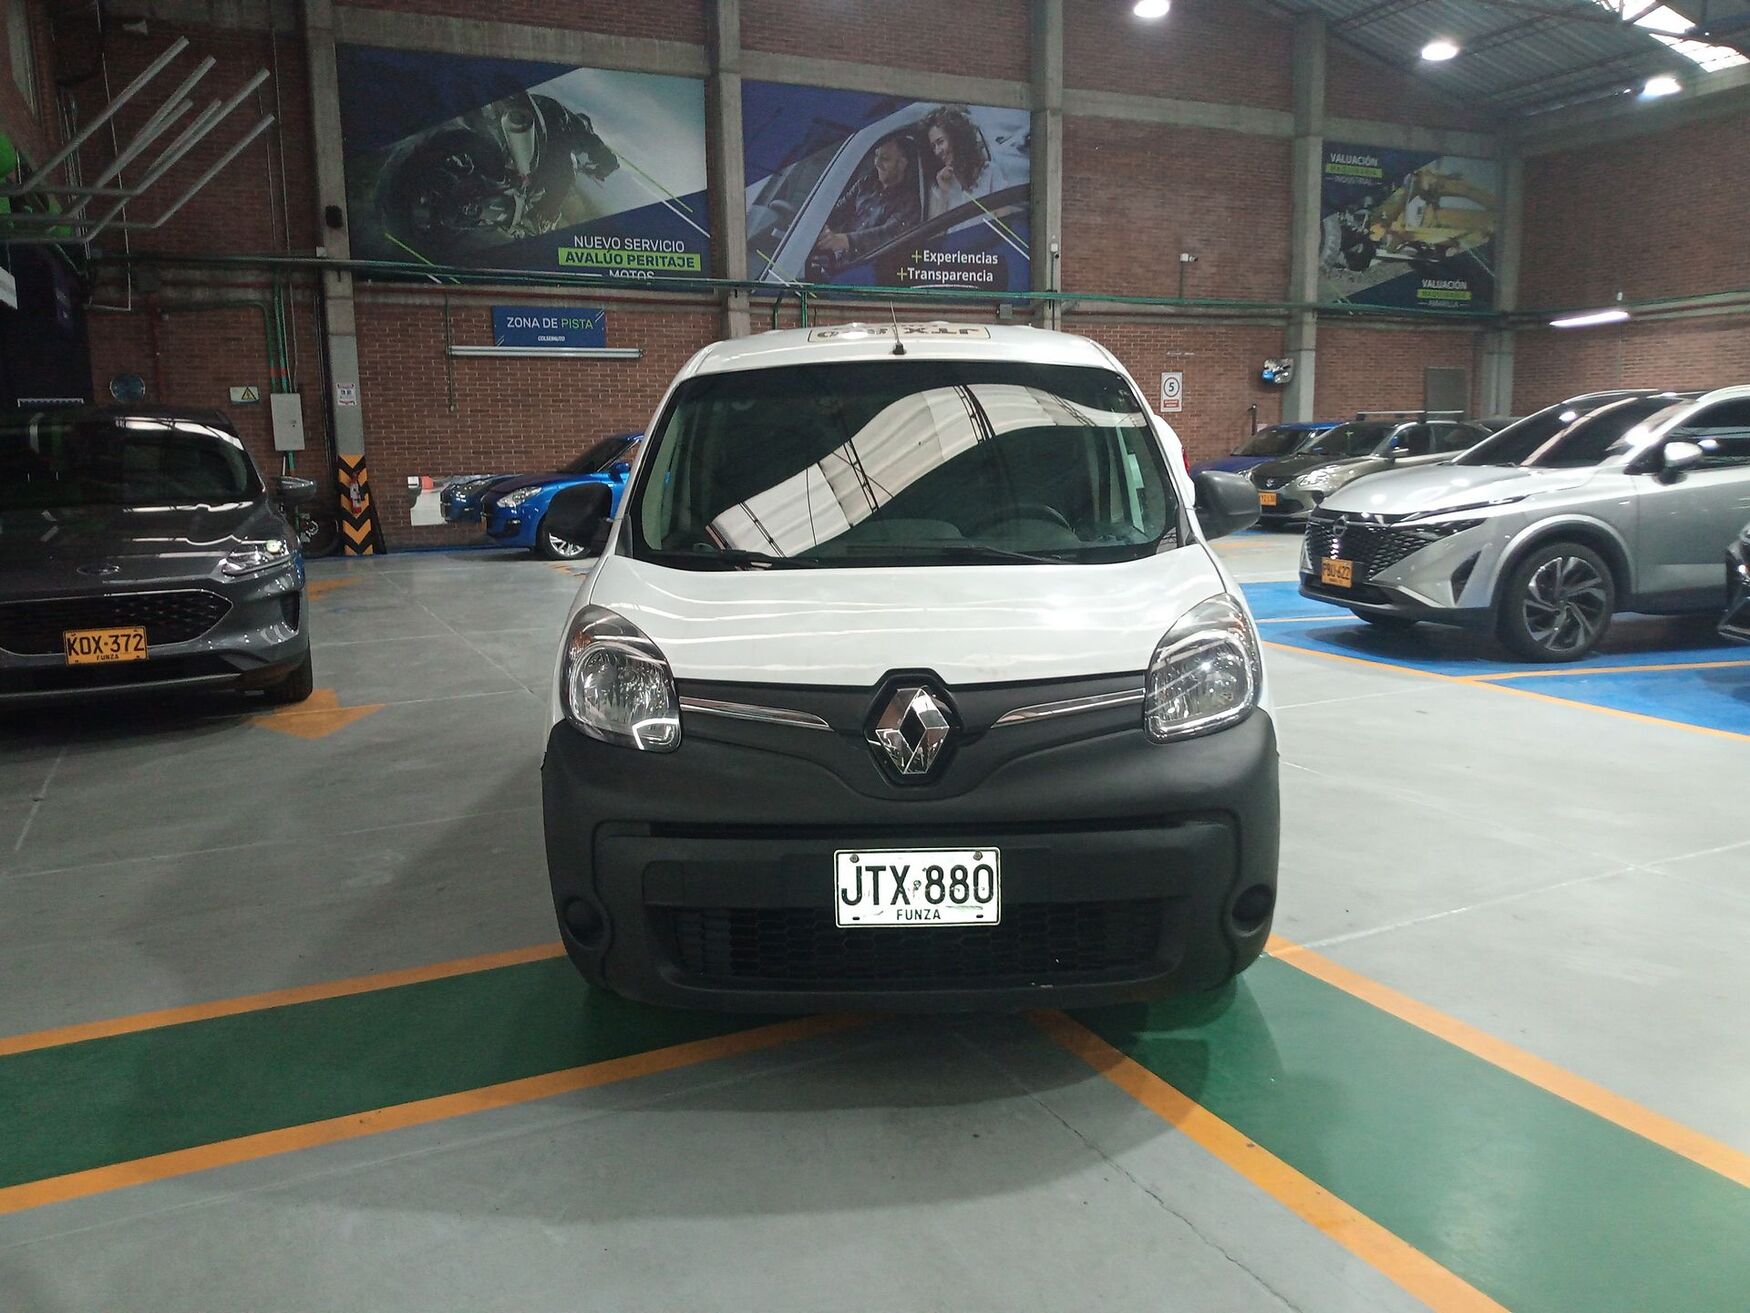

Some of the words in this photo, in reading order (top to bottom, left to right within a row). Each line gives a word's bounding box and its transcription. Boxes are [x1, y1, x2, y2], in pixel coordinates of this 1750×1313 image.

[574, 235, 621, 250] NUEVO
[624, 238, 685, 253] SERVICIO
[565, 250, 623, 266] AVALÚO
[627, 254, 695, 269] PERITAJE
[506, 317, 540, 329] ZONA
[543, 318, 558, 329] DE
[561, 319, 593, 330] PISTA
[1168, 382, 1175, 392] 5
[896, 908, 942, 921] FUNZA
